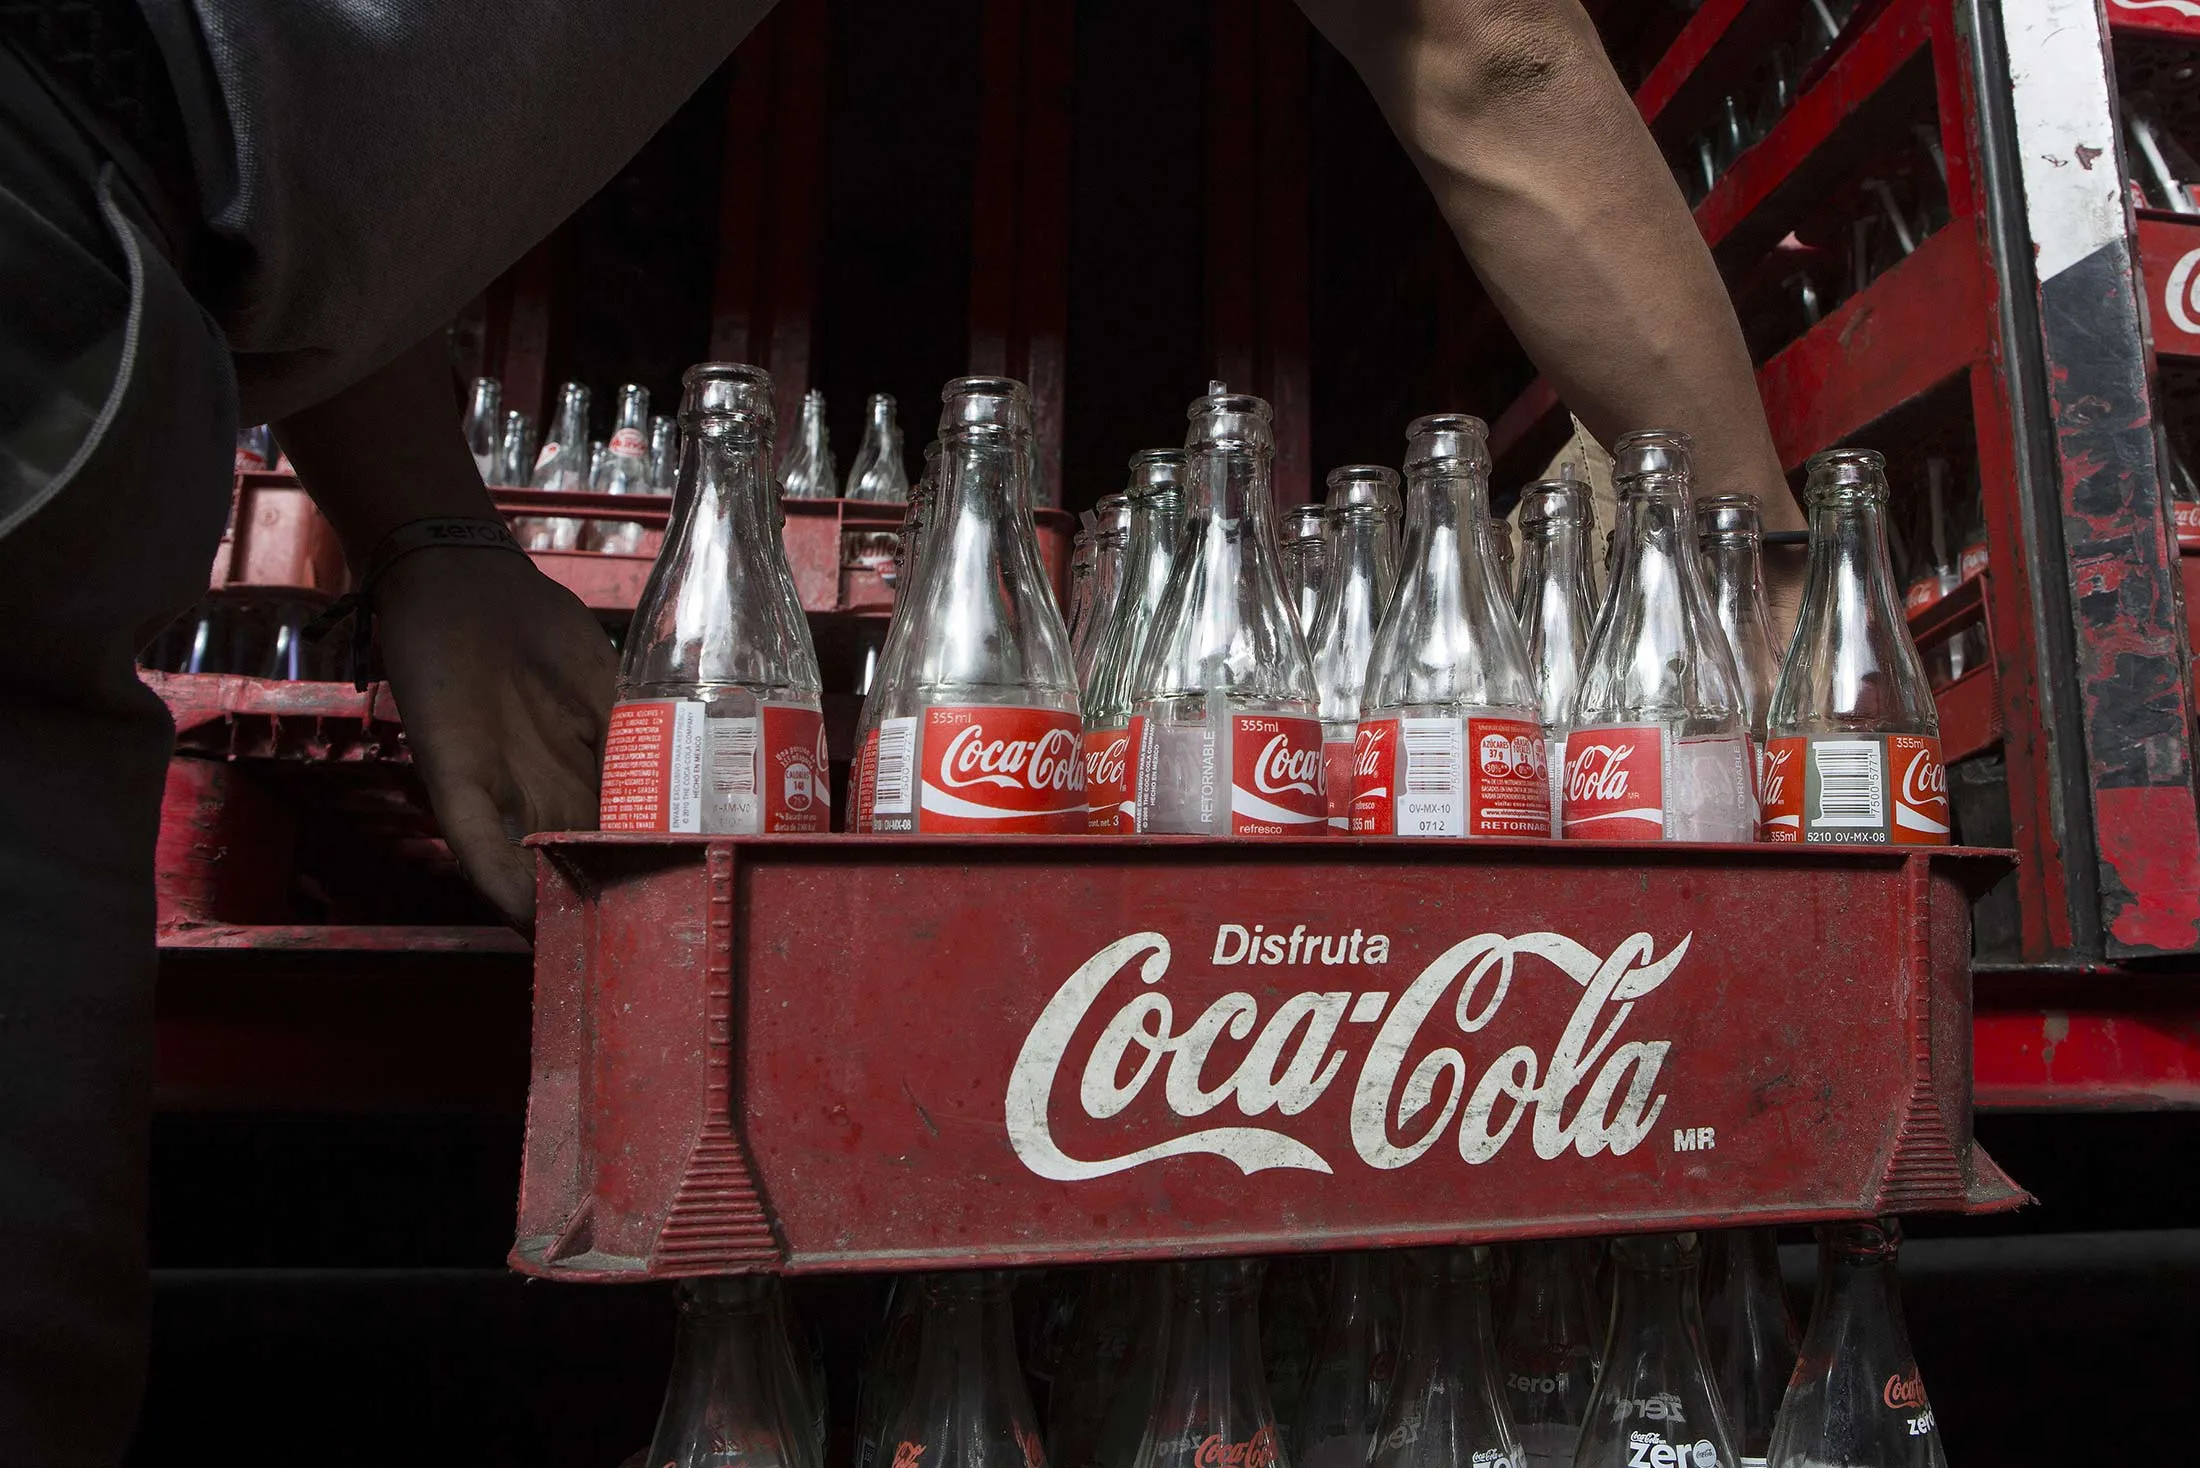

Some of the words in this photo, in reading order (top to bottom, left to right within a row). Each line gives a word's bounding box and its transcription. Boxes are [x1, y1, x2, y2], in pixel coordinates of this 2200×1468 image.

[932, 712, 973, 724] 355ml
[1241, 720, 1279, 732] 355ml
[1146, 722, 1155, 754] COMPANY
[1896, 738, 1924, 749] 355ml
[941, 724, 1085, 791] Coca-Cola
[1137, 771, 1145, 807] EXCLUSIVO
[1141, 718, 1151, 752] REFRESCO
[693, 763, 701, 773] EN
[1869, 753, 1880, 781] 5771
[1151, 771, 1157, 781] EN
[1201, 731, 1215, 823] RETORNABLE
[1409, 803, 1451, 814] OV-MX-10
[1870, 785, 1880, 815] 7500
[1240, 825, 1282, 835] refresco
[1419, 821, 1445, 831] 0712
[1771, 831, 1797, 842] 355ml
[1807, 832, 1832, 842] 5210
[1835, 832, 1886, 842] OV-MX-08
[1212, 924, 1391, 966] Disfruta
[1005, 930, 1692, 1182] Coca-Cola
[1673, 1127, 1717, 1152] MR
[1506, 1371, 1556, 1394] zero
